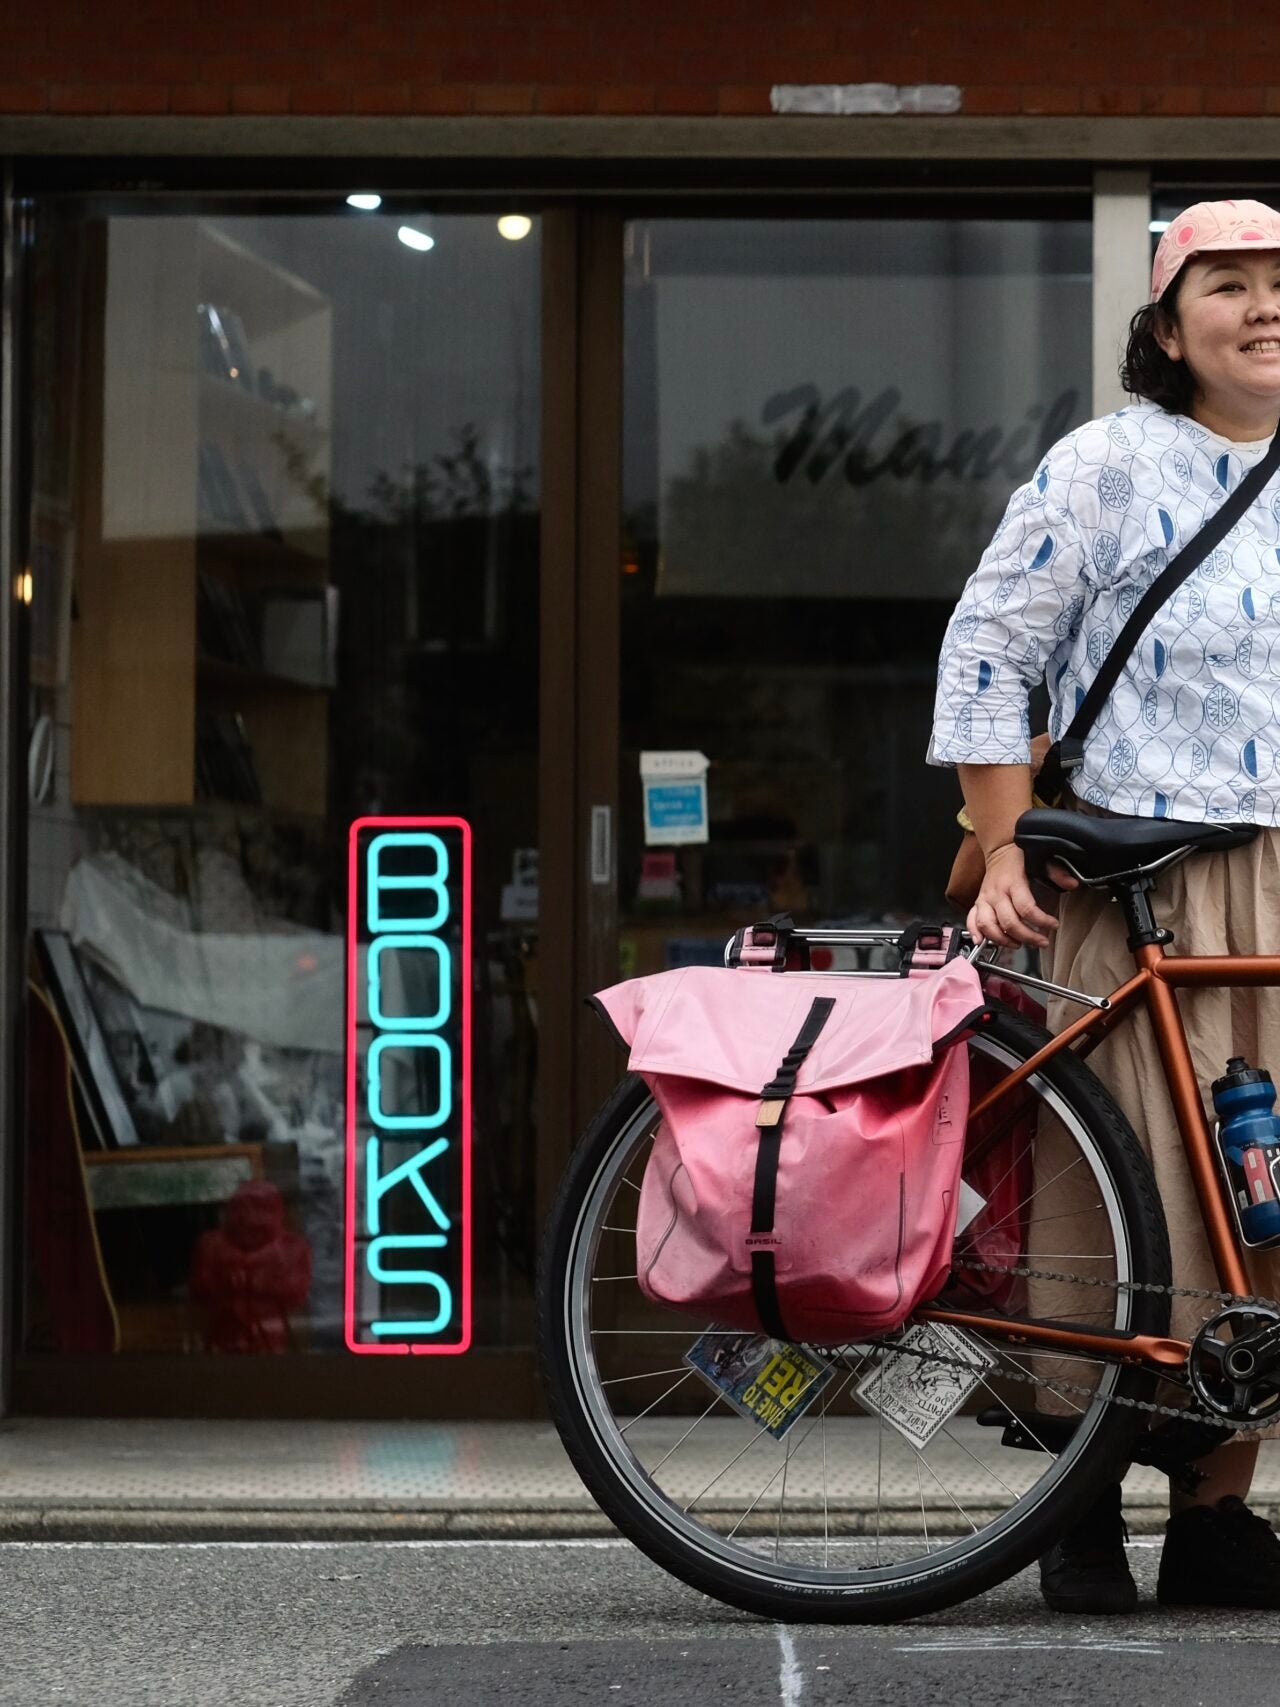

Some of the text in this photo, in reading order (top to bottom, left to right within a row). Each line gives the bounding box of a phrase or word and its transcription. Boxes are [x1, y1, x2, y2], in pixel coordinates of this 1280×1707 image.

[367, 833, 452, 1335] BOOKS
[742, 1385, 788, 1429] BIKE TO
[755, 1352, 804, 1411] REI
